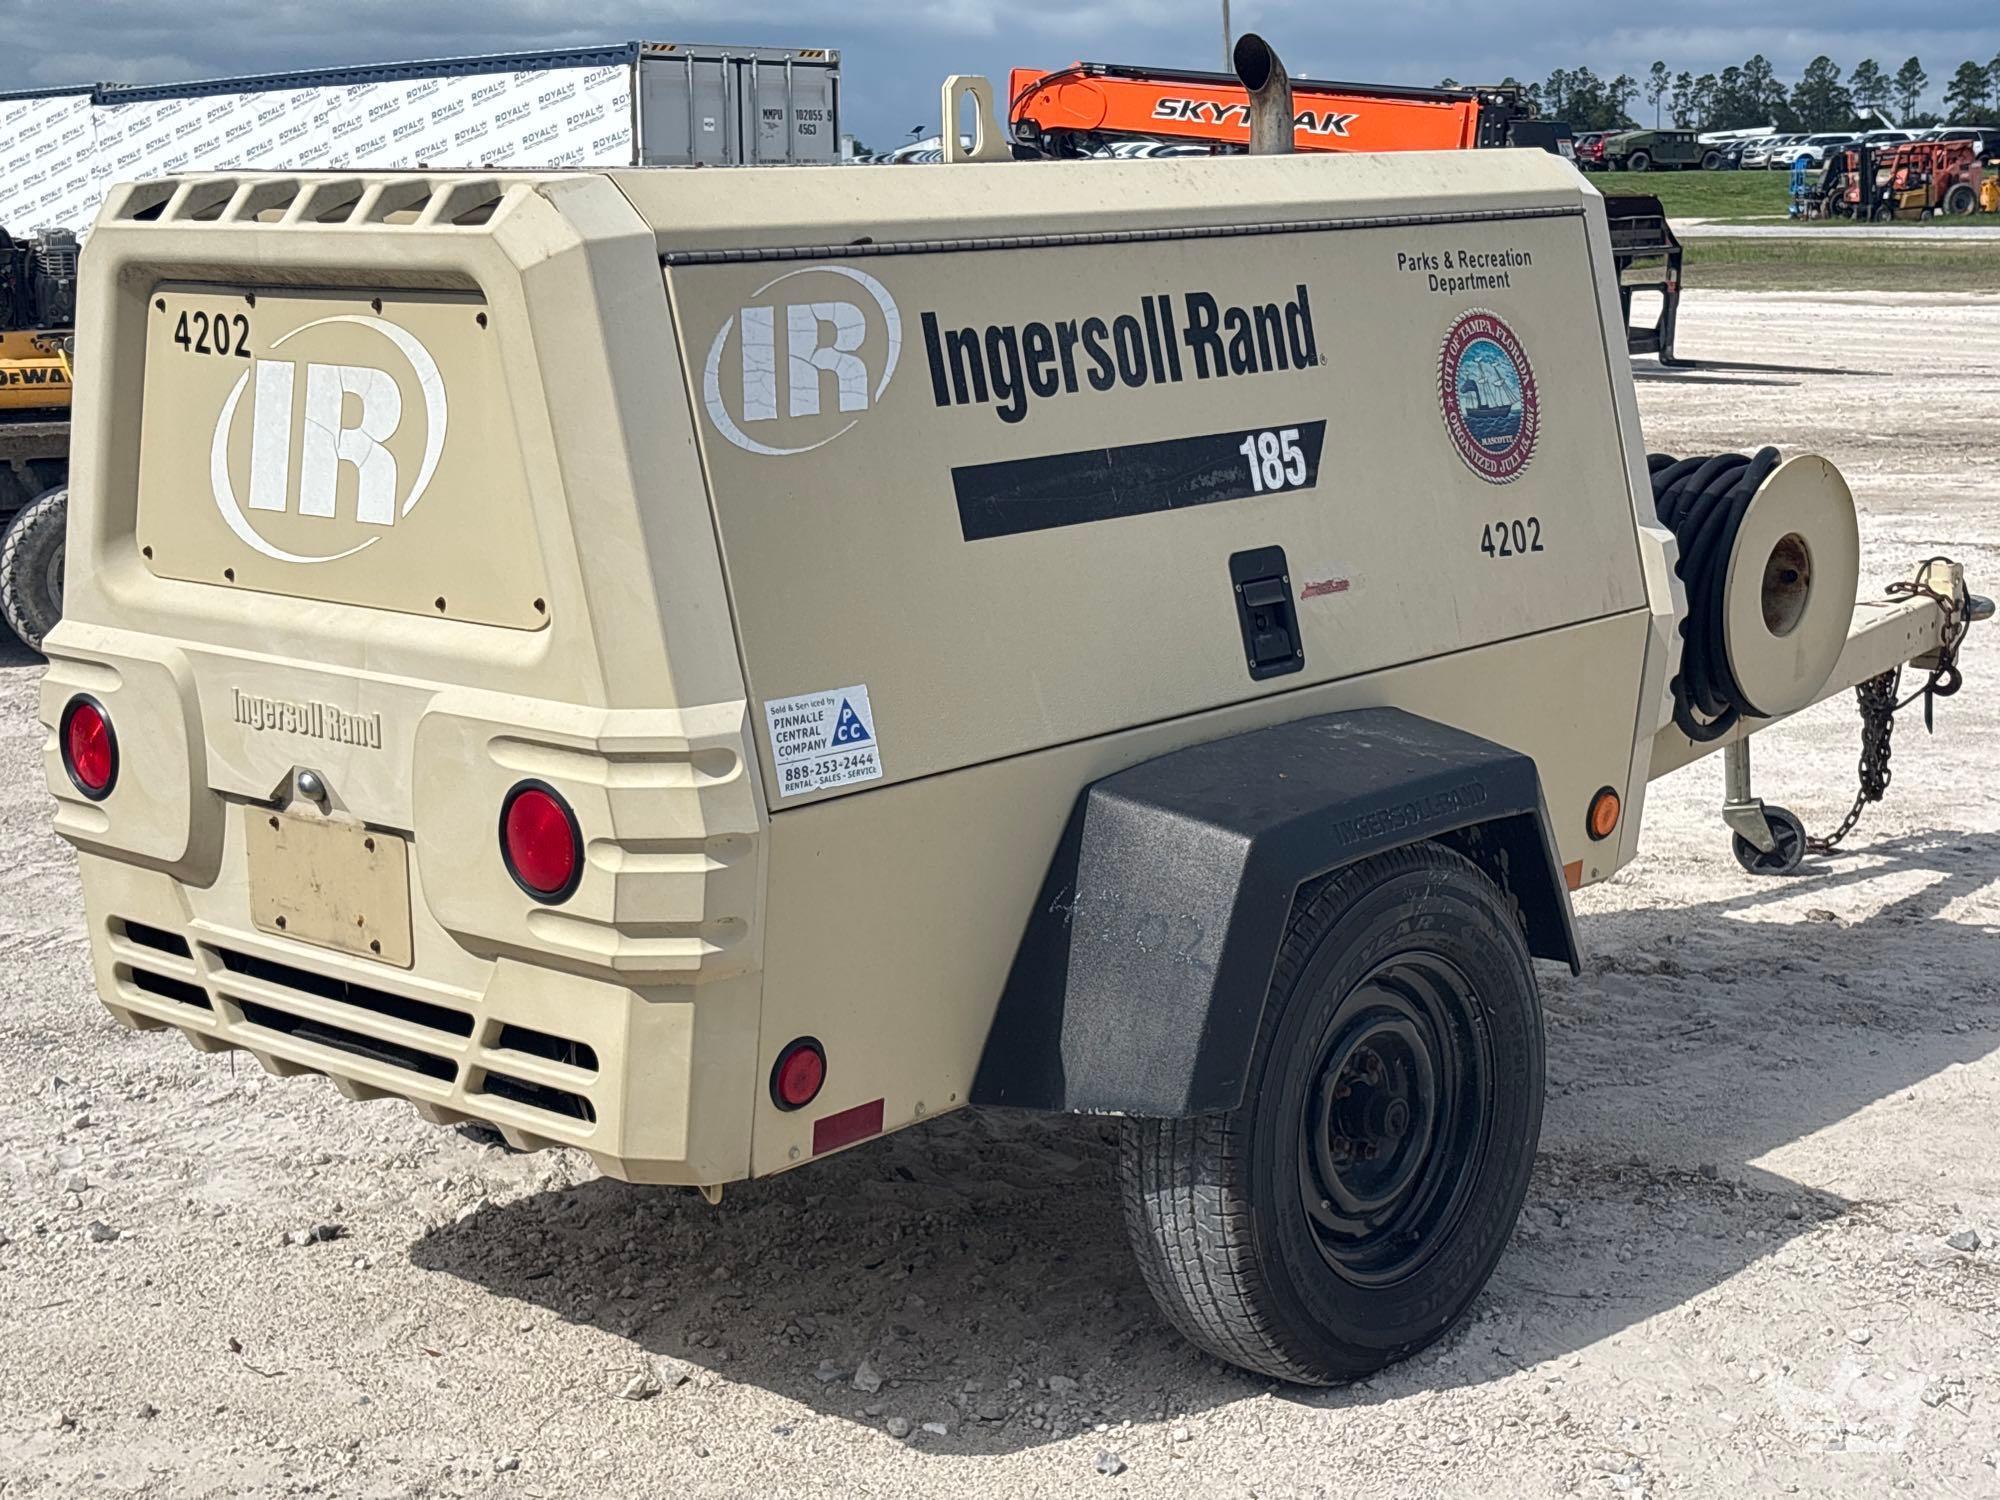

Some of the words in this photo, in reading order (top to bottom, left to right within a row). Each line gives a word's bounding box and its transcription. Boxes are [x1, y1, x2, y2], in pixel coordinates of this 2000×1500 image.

[584, 68, 613, 84] ROYAL
[407, 83, 432, 99] ROYAL
[472, 84, 498, 101] ROYAL
[539, 87, 567, 104] ROYAL
[613, 92, 631, 106] ROY
[369, 102, 393, 117] ROYAL
[432, 103, 457, 119] ROYAL
[495, 107, 523, 123] ROYAL
[567, 109, 596, 125] ROYAL
[762, 109, 783, 120] MMPU
[796, 109, 823, 121] 102055
[1153, 99, 1357, 135] SKYTAK
[332, 119, 356, 134] ROYAL
[393, 122, 417, 137] ROYAL
[455, 125, 481, 141] ROYAL
[522, 128, 551, 144] ROYAL
[593, 132, 622, 150] ROYAL
[299, 145, 322, 160] ROYAL
[356, 139, 379, 154] ROYAL
[415, 143, 440, 158] ROYAL
[481, 147, 507, 163] ROYAL
[548, 151, 577, 167] ROYAL
[1398, 252, 1438, 271] Parks
[1444, 251, 1454, 269] &
[1458, 249, 1532, 269] Recreation
[1429, 271, 1511, 295] Department
[174, 311, 252, 358] 4202
[741, 302, 869, 421] IR
[1444, 357, 1456, 393] CITY
[1451, 335, 1461, 355] OF
[1458, 319, 1495, 342] TAMPA,
[1495, 326, 1530, 386] FLORIDA
[0, 369, 67, 386] DEWA
[249, 359, 402, 526] IR
[1450, 412, 1497, 473] ORGANIZED
[1500, 454, 1521, 474] JULY
[1526, 406, 1536, 437] 1887
[1482, 435, 1514, 446] MASCOTTE
[1240, 429, 1308, 493] 185
[1481, 517, 1545, 558] 4202
[770, 705, 787, 716] Sold
[827, 698, 836, 707] by
[774, 711, 824, 730] PINNACLE
[842, 709, 852, 724] P
[776, 726, 822, 743] CENTRAL
[778, 738, 828, 757] COMPANY
[785, 753, 874, 782] 888-253-2444
[785, 781, 813, 792] RENTAL
[819, 773, 842, 785] SALES
[848, 767, 877, 779] SERVICE
